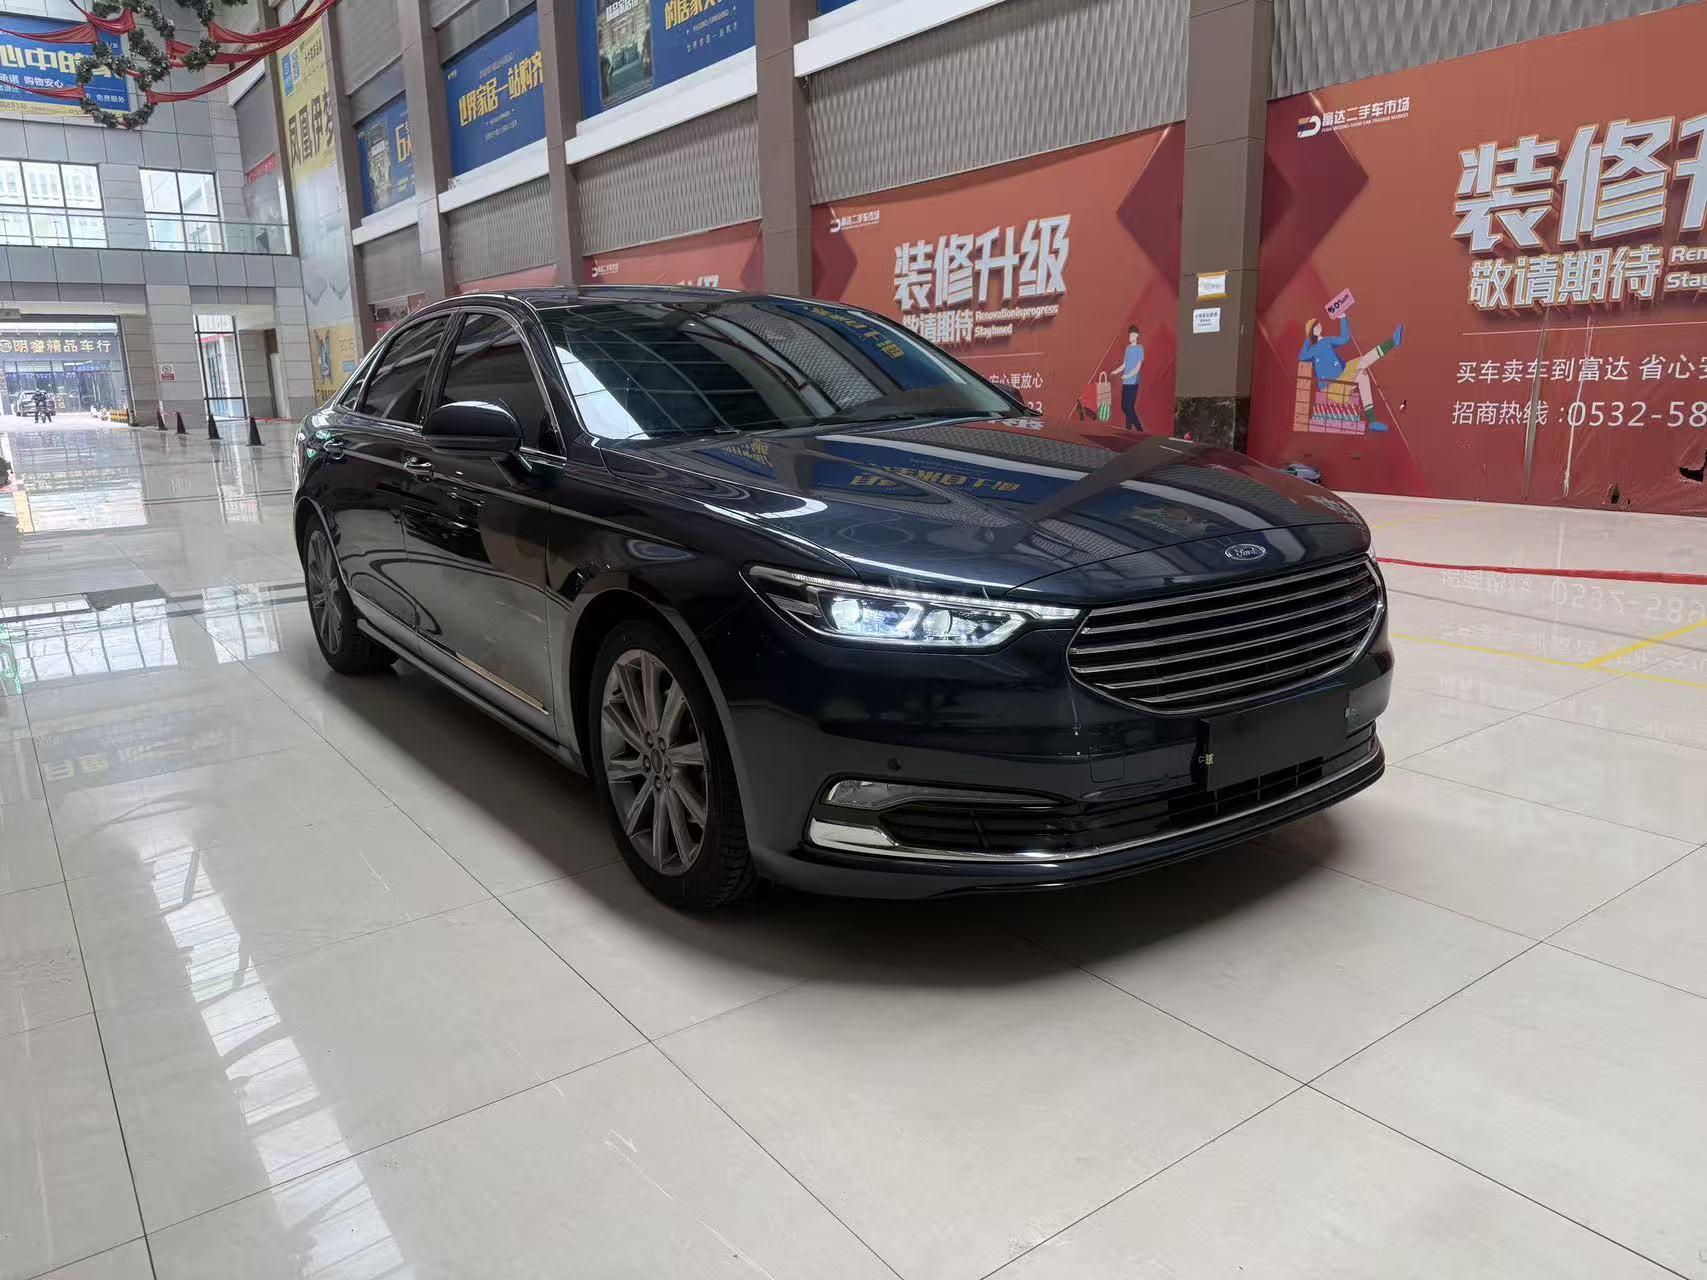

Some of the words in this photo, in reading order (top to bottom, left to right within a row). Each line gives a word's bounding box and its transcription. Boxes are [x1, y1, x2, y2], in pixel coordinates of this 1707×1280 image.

[24, 76, 64, 88] 购物安心
[1322, 96, 1410, 127] 富达二手车市场
[895, 214, 1071, 310] 装修升级
[1470, 246, 1661, 309] 敬请期待
[903, 309, 974, 342] 敬请期待
[1456, 355, 1631, 385] 买车卖车到富达
[1451, 400, 1549, 426] 招商热线
[1234, 547, 1258, 558] Ford
